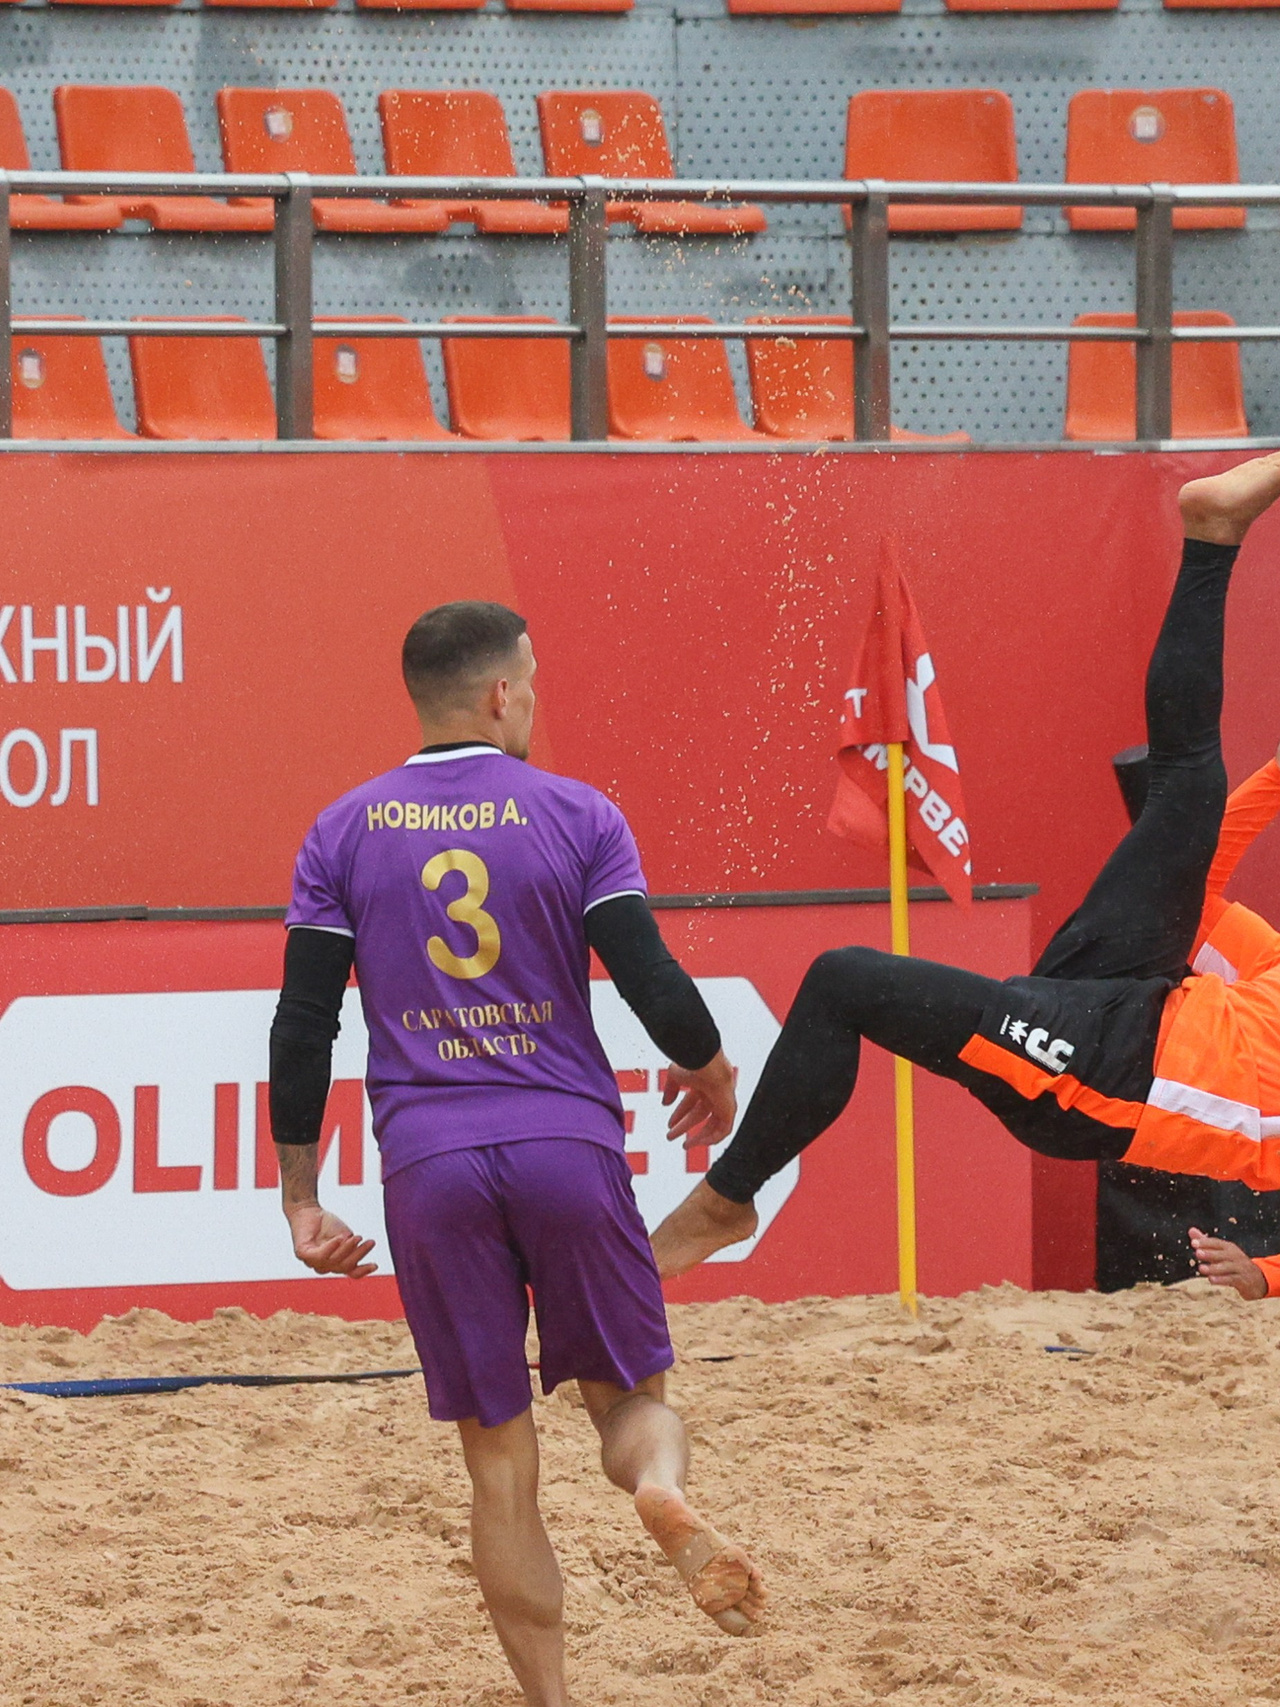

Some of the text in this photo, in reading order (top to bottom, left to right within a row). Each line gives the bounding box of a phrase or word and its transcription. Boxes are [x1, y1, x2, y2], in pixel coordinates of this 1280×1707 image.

[366, 798, 528, 832] НОВИКОВ А.
[421, 848, 501, 980] 3
[402, 1001, 553, 1031] САРАТОВСКАЯ
[438, 1033, 537, 1061] ОБЛАСТЬ
